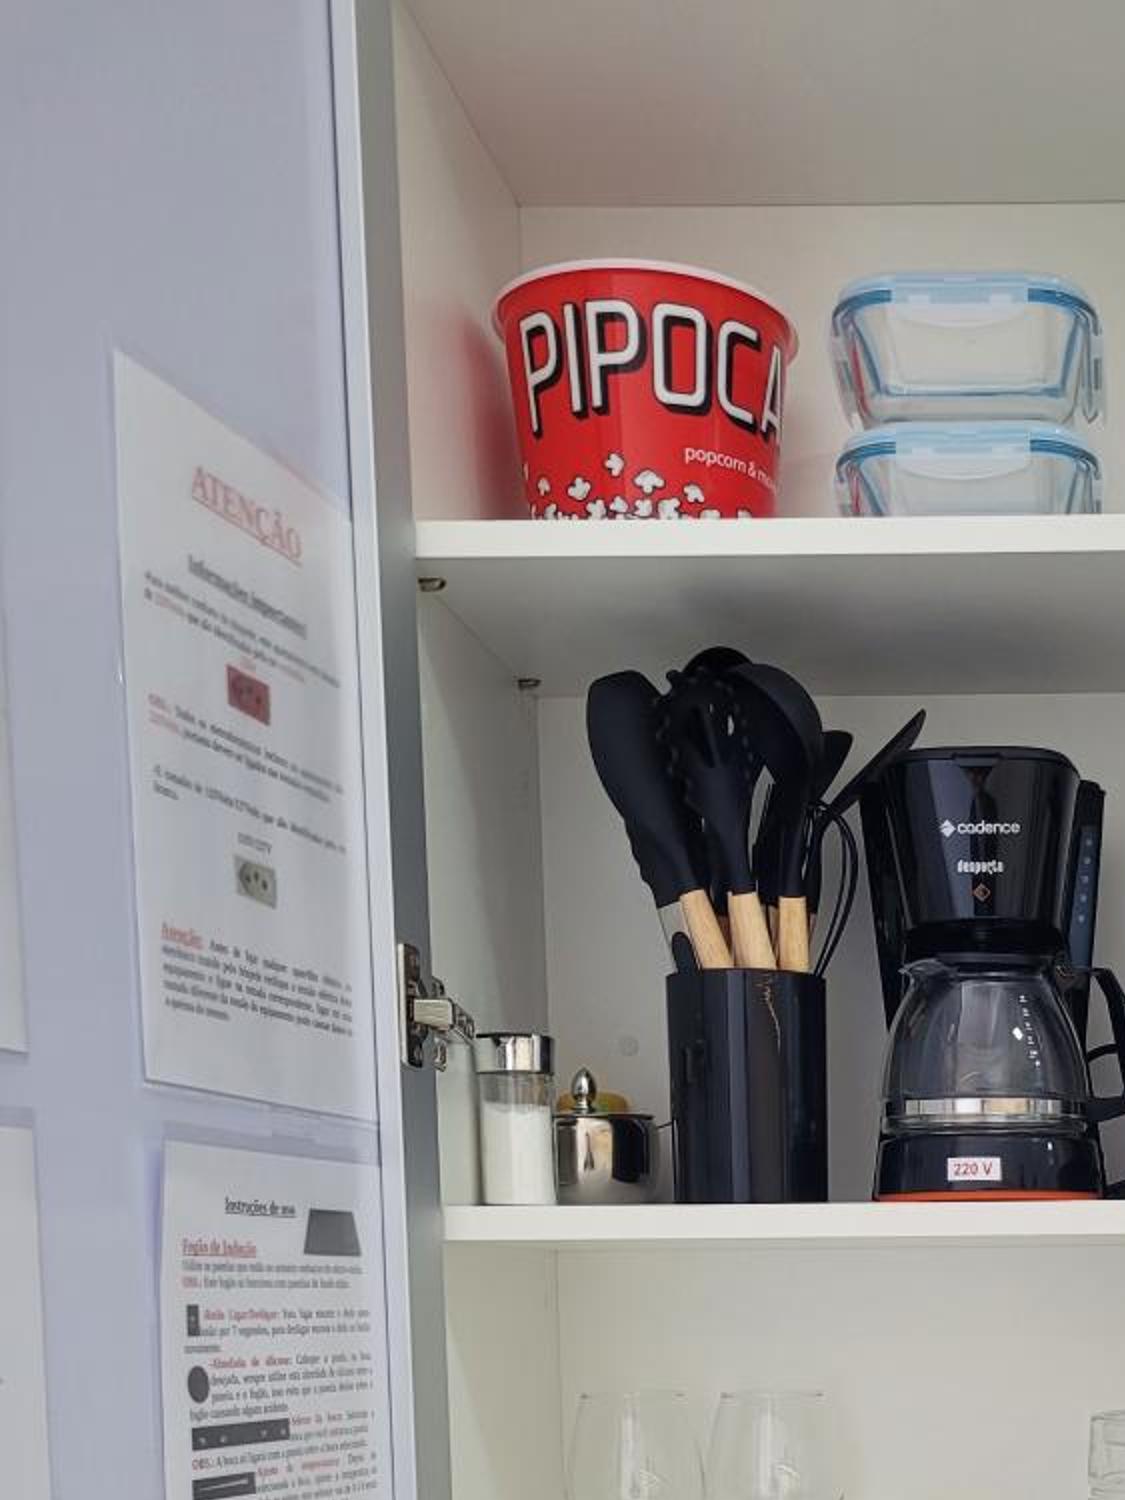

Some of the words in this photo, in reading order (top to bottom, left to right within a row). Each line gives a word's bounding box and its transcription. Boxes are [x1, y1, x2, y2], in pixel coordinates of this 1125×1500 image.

[519, 299, 784, 446] PIPOCA
[684, 447, 746, 473] popcorn
[747, 461, 757, 478] &
[192, 466, 303, 567] ATENÇÃO
[958, 820, 1020, 835] cadence
[953, 1163, 978, 1175] 220
[981, 1162, 993, 1175] V
[225, 1196, 268, 1216] Instruções
[270, 1201, 279, 1215] de
